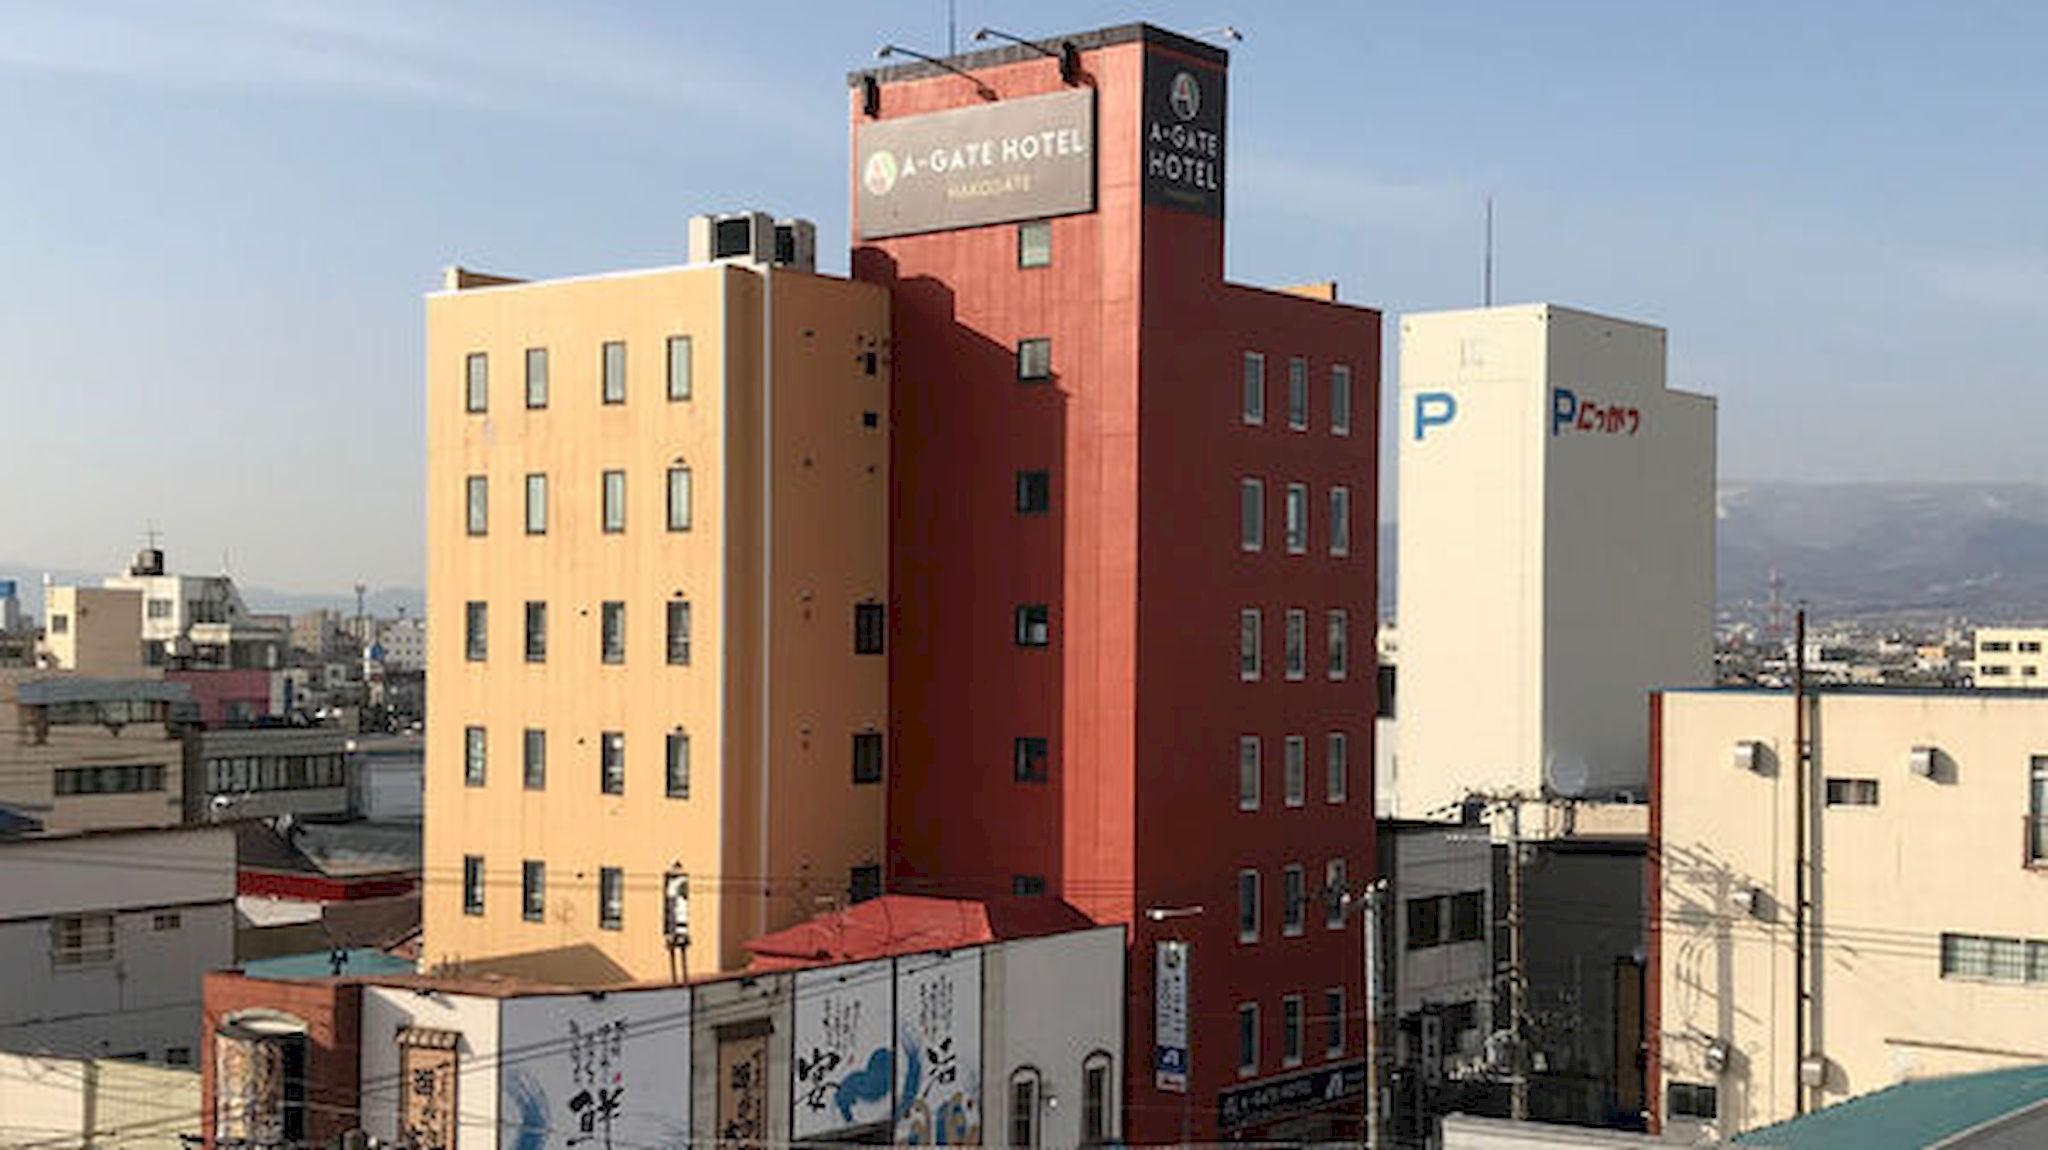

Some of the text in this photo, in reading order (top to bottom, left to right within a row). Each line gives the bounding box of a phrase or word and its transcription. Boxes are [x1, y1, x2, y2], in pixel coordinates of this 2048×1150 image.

[902, 128, 1084, 177] A-GATE HOTEL
[1149, 122, 1217, 159] A-GATE
[1149, 148, 1218, 191] HOTEL
[1414, 392, 1457, 440] P
[1553, 387, 1576, 436] P
